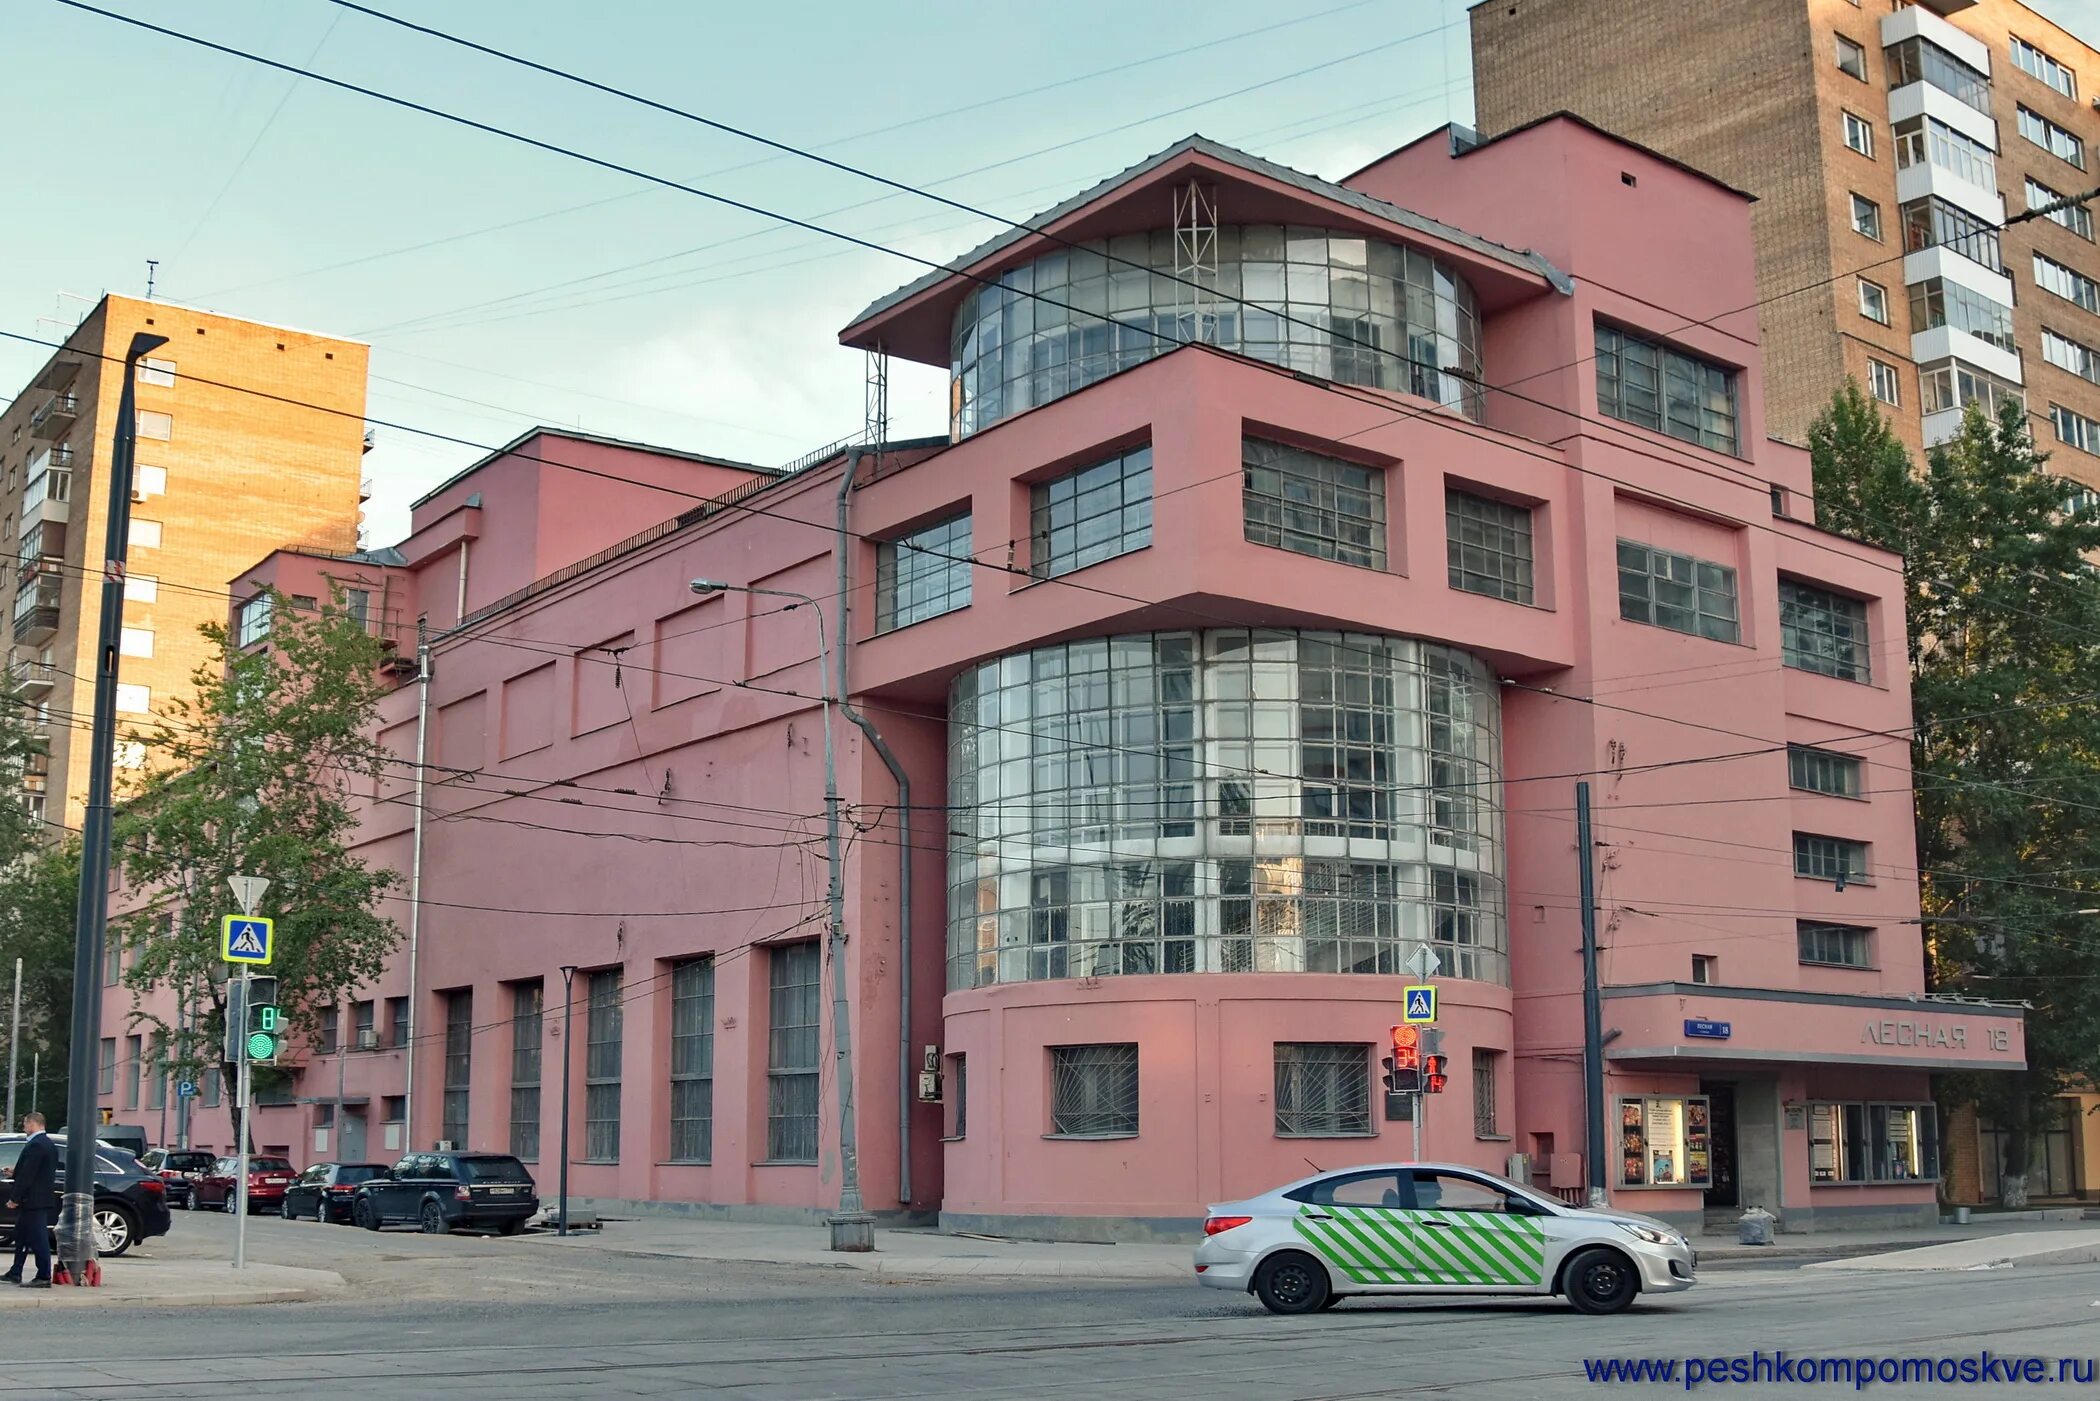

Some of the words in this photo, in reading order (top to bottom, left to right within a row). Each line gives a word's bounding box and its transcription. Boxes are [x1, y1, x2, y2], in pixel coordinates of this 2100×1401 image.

[262, 1007, 274, 1030] 8
[1861, 1019, 1968, 1050] ЛЕСНАЯ
[1986, 1027, 2009, 1051] 18
[1397, 1048, 1418, 1068] 34
[180, 1081, 192, 1096] P
